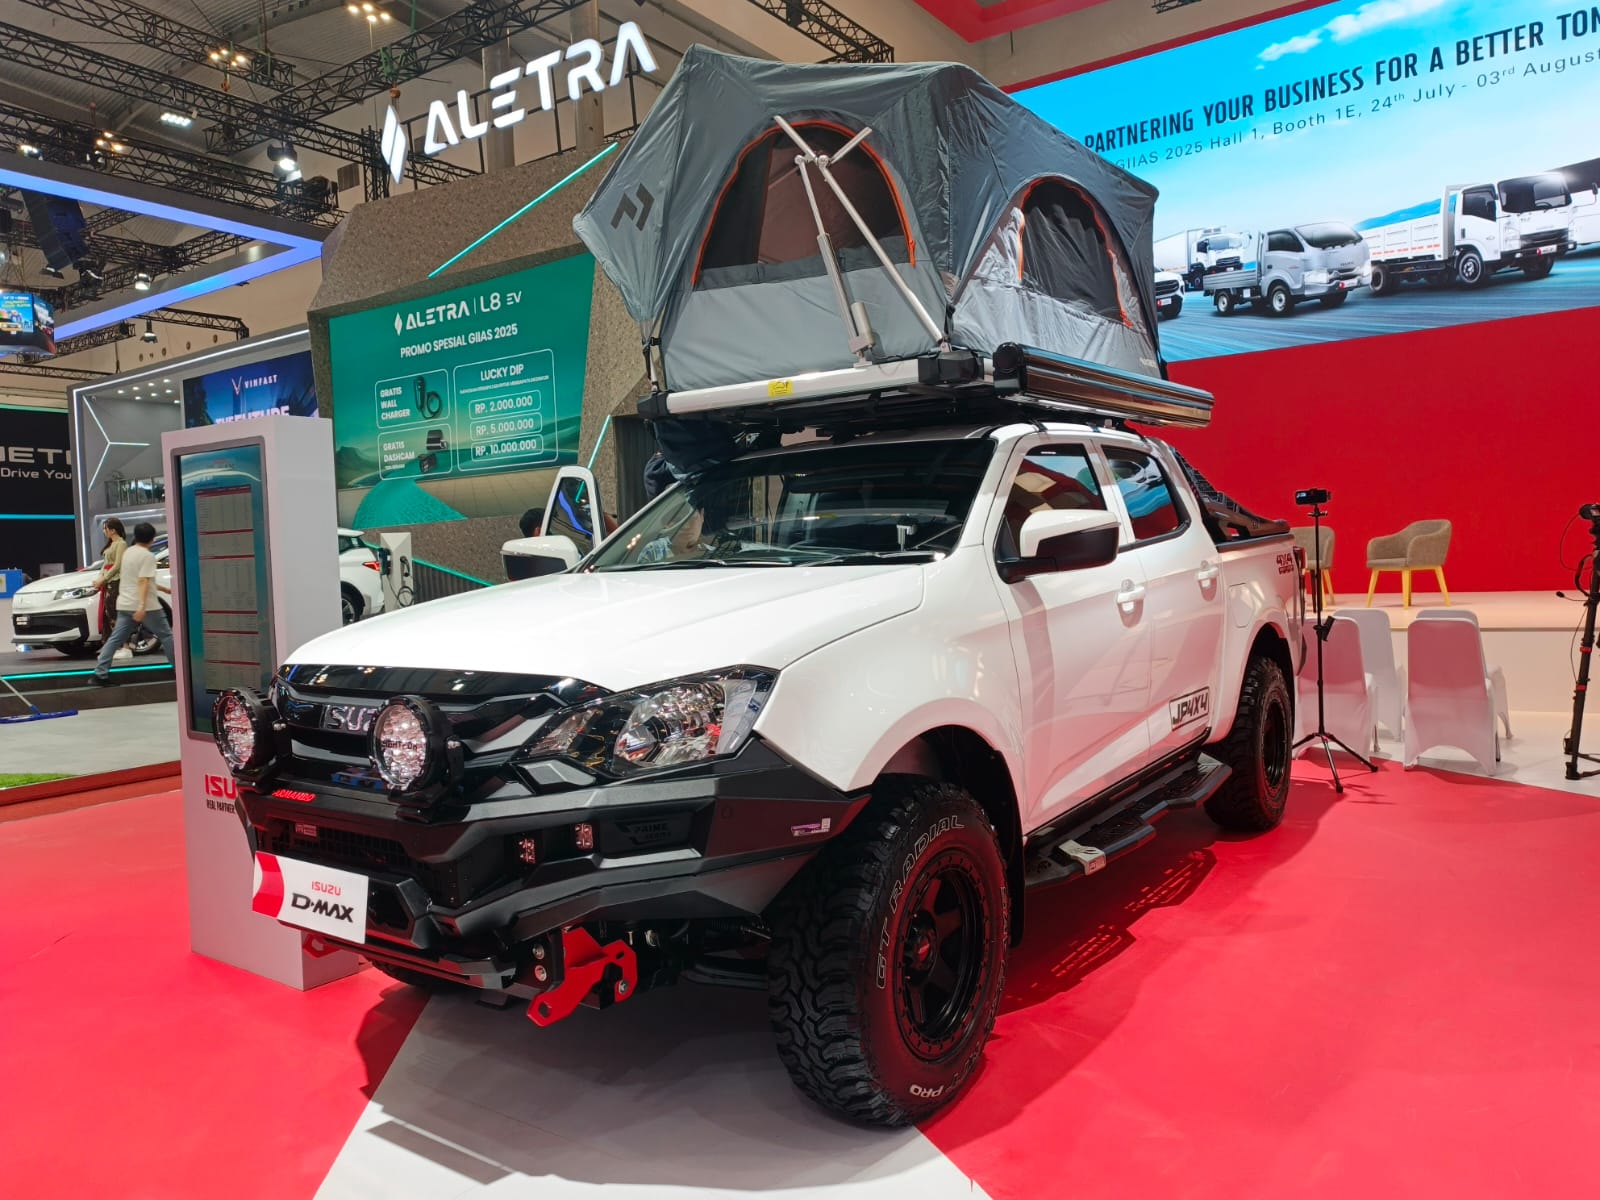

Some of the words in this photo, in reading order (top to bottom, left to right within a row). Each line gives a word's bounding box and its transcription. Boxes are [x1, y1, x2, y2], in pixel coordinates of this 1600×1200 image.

[424, 21, 657, 155] ALETRA
[1084, 108, 1194, 153] PARTNERING
[1203, 94, 1254, 127] YOUR
[1264, 65, 1364, 113] BUSINESS
[1375, 53, 1418, 86] FOR
[1429, 46, 1444, 72] A
[1456, 21, 1544, 66] BETTER
[1115, 151, 1159, 170] GIIAS
[1165, 141, 1203, 161] 2025
[1210, 131, 1243, 150] Hall
[1252, 127, 1265, 140] 1,
[1273, 113, 1325, 135] Booth
[1335, 104, 1362, 121] 1E,
[1371, 92, 1405, 112] 24th
[1413, 83, 1456, 103] July
[1476, 66, 1516, 88] 03rd
[405, 300, 470, 331] ALETRA
[480, 291, 501, 313] L8
[506, 290, 522, 306] EV
[400, 342, 432, 358] PROMO
[433, 334, 468, 352] SPESIAL
[468, 329, 493, 344] GIIAS
[494, 322, 518, 339] 2025
[480, 366, 508, 381] LUCKY
[509, 363, 525, 376] DIP
[244, 374, 278, 389] VINFAST
[380, 386, 403, 398] GRATIS
[380, 399, 398, 409] WALL
[489, 395, 533, 412] 2.000.000
[381, 408, 411, 420] CHARGER
[490, 418, 534, 435] 5.000.000
[383, 441, 405, 451] GRATIS
[490, 439, 537, 455] 10.000.000
[0, 446, 71, 465] ET
[383, 451, 415, 463] DASHCAM
[0, 467, 40, 479] Drive
[311, 880, 341, 896] ISUZU
[876, 917, 890, 989] GT
[889, 815, 965, 914] RADIAL
[909, 1084, 944, 1098] PRO
